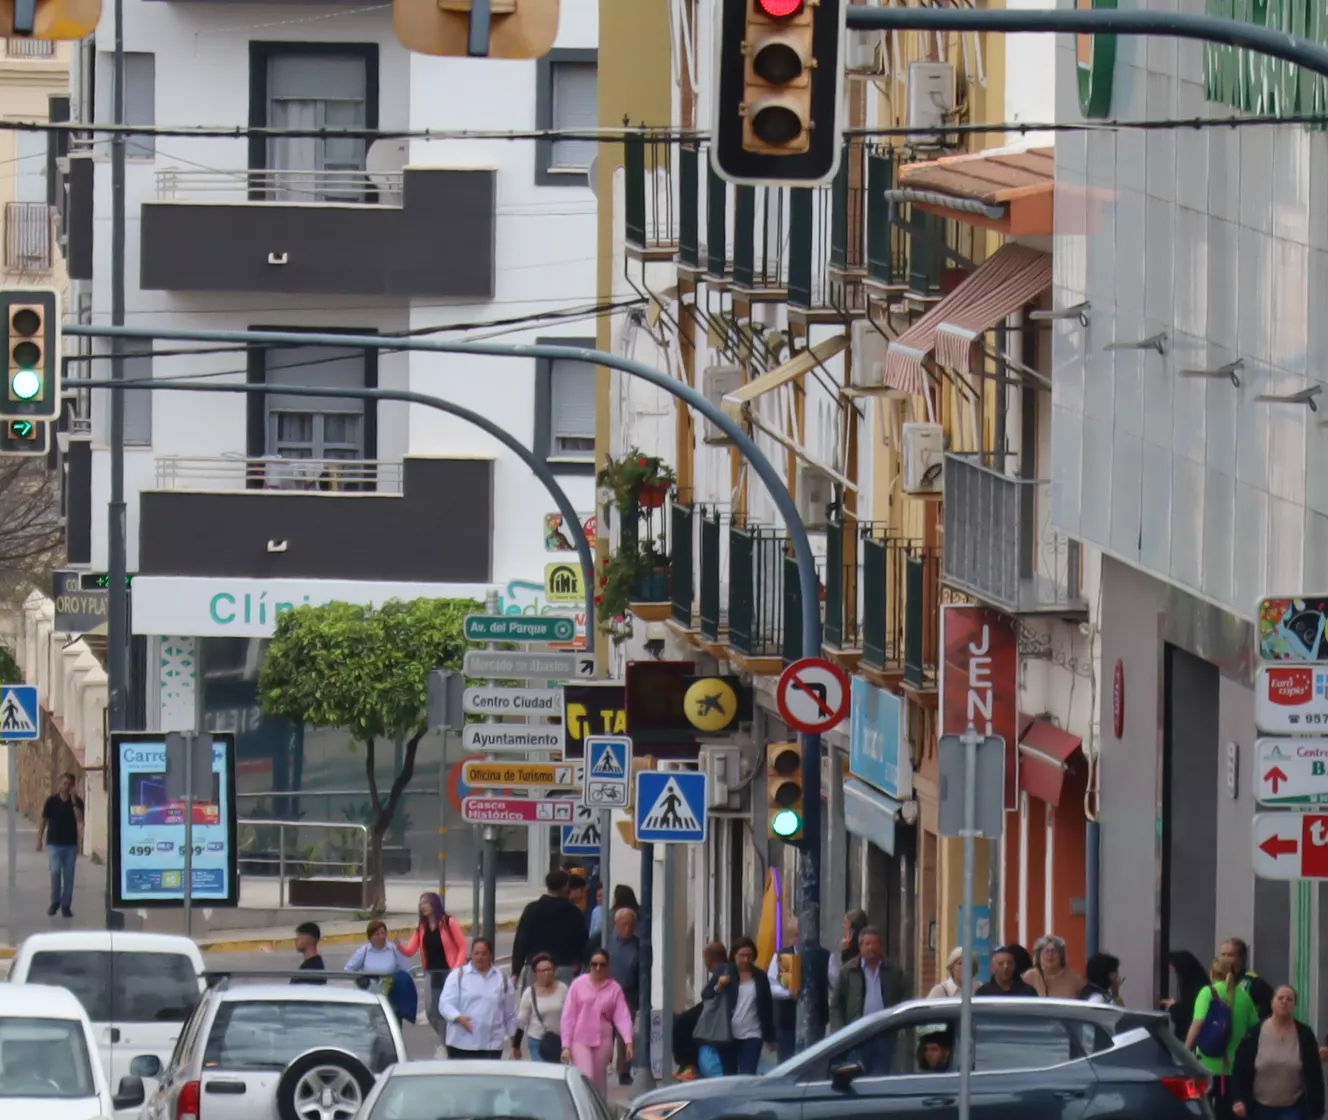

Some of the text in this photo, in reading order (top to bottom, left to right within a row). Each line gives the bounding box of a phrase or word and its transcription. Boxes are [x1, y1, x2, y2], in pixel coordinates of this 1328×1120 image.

[56, 596, 109, 615] ORO Y PLA
[471, 622, 547, 635] Av. del Parque
[471, 659, 513, 671] Mercado
[530, 660, 570, 672] Abastos
[968, 624, 993, 735] JEN
[472, 695, 553, 709] Centro Ciudad
[472, 732, 558, 747] Ayuntamiento
[124, 748, 167, 763] Carre
[470, 769, 553, 782] Oficina de Turismo
[468, 800, 506, 810] Casco
